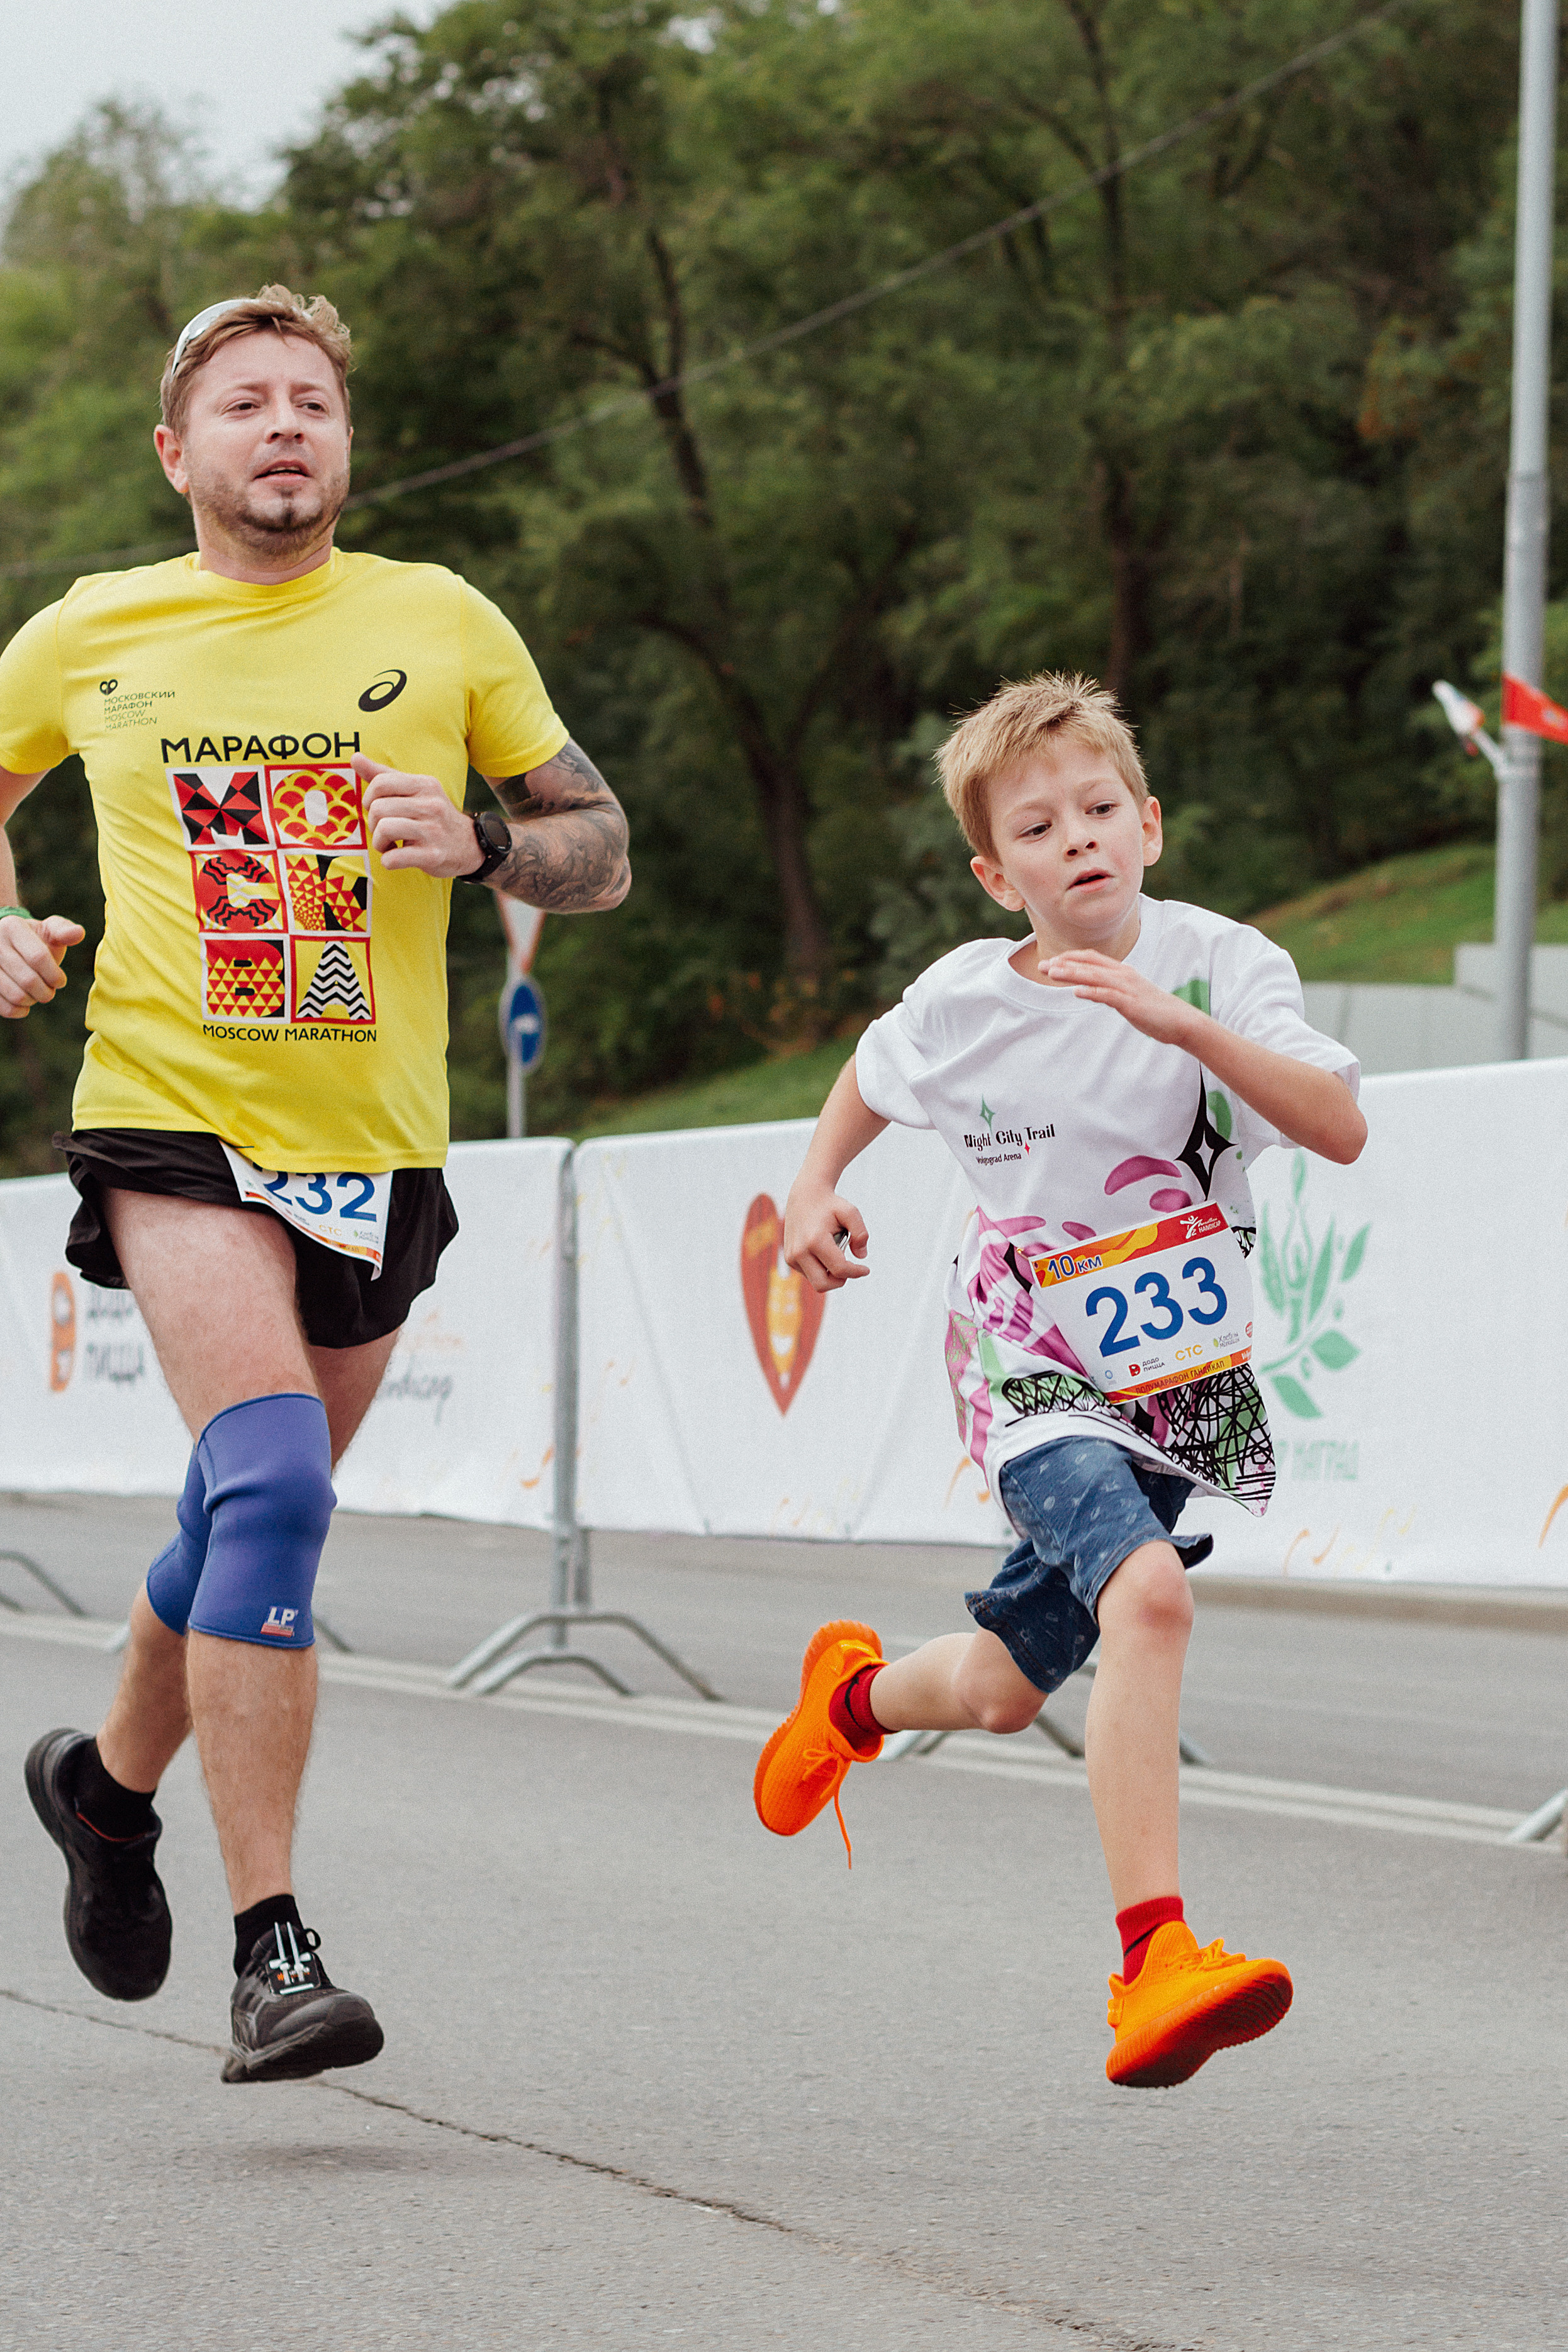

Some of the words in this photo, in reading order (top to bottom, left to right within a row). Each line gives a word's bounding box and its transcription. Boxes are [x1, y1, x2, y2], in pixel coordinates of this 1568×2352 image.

[104, 700, 152, 714] МАРАФОН
[104, 709, 145, 723] MOSCOW
[105, 717, 157, 731] MARATHON
[160, 732, 361, 763] МАРАФОН
[203, 1024, 279, 1041] MOSCOW
[285, 1028, 377, 1042] MARATHON
[964, 1133, 992, 1151] Night
[995, 1129, 1023, 1146] City
[1024, 1124, 1055, 1140] Trail
[976, 1154, 1002, 1166] Volgograd
[1004, 1153, 1022, 1162] Arena
[252, 1162, 377, 1223] 232
[1085, 1257, 1228, 1357] 233
[1142, 1357, 1160, 1367] ДОДО
[1143, 1361, 1165, 1372] ПИЦЦА
[1135, 1372, 1189, 1394] ПОЛУМАРАФОН
[1190, 1360, 1225, 1379] ГАНДИКАП
[267, 1607, 295, 1625] LP
